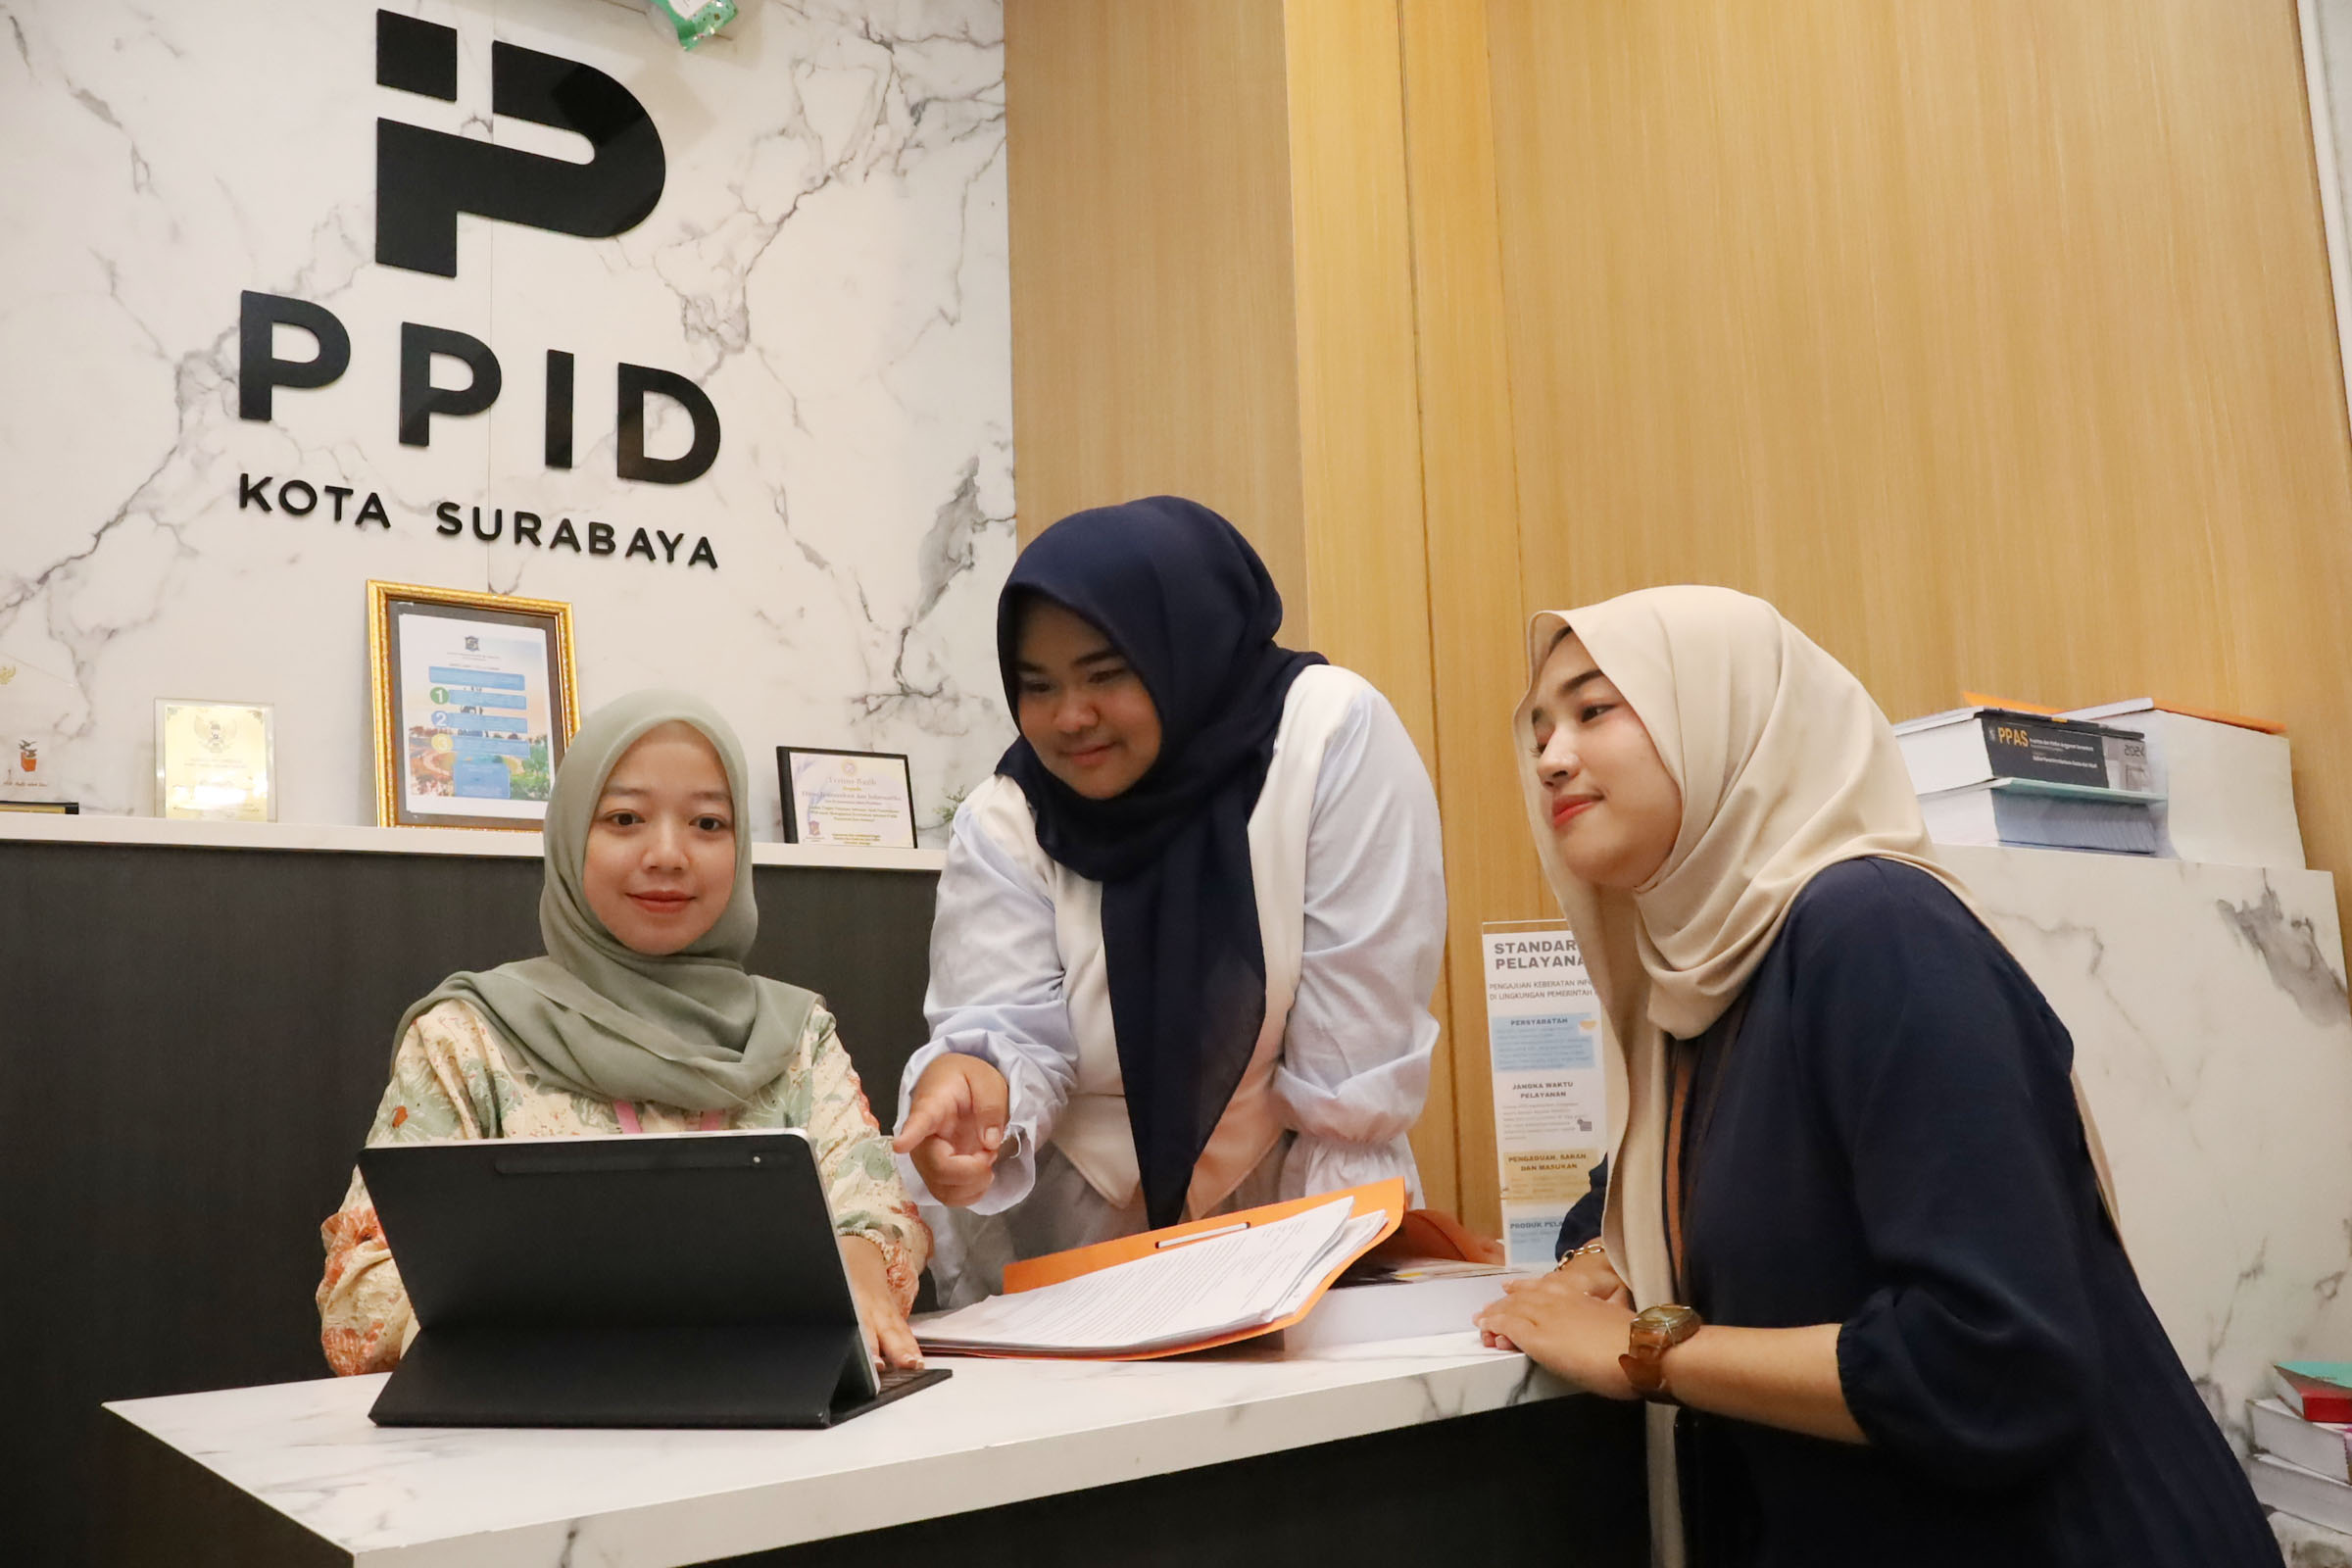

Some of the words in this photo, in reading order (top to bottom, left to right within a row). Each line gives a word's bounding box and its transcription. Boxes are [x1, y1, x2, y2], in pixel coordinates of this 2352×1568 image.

[239, 290, 721, 484] PPID
[239, 473, 391, 528] KOTA
[436, 502, 719, 569] SURABAYA
[1998, 726, 2029, 747] PPAS
[1490, 981, 1532, 990] PENGAJUAN
[1534, 979, 1575, 988] KEBERATAN
[1498, 991, 1545, 1000] LINGKUNGAN
[1547, 989, 1592, 998] PEMERINTAH
